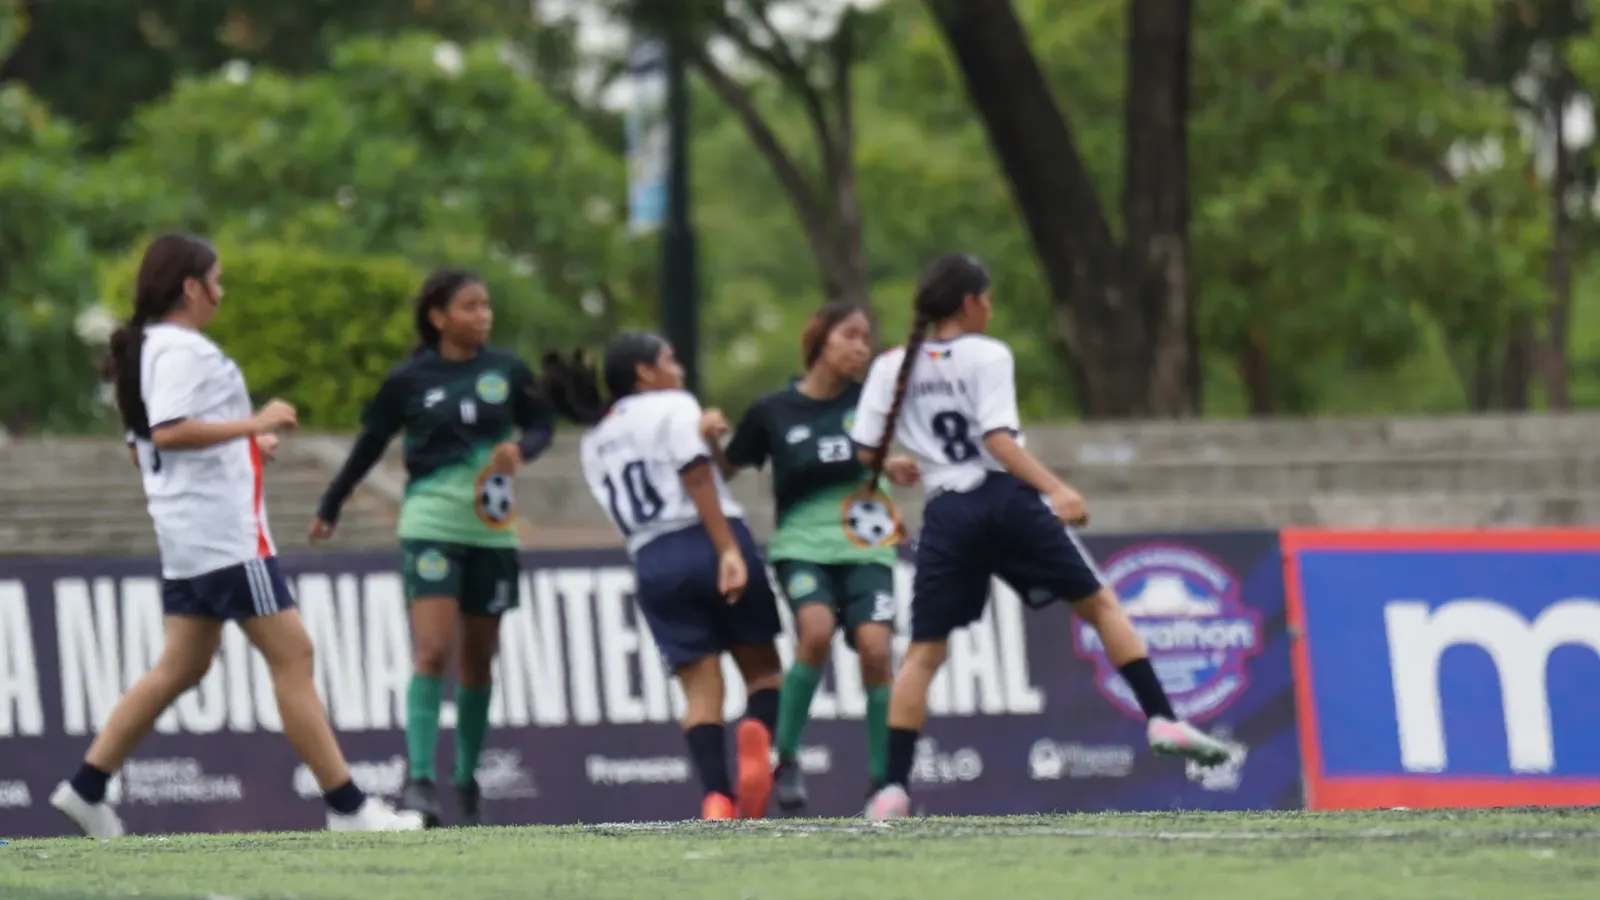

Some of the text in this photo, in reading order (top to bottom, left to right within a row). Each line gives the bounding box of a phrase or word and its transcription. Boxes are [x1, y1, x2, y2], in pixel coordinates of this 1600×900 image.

[818, 436, 851, 463] 23
[932, 411, 981, 464] 8
[602, 459, 666, 537] 10
[488, 563, 1046, 728] INTERAL
[1079, 618, 1255, 651] mrathon
[1384, 597, 1600, 774] m
